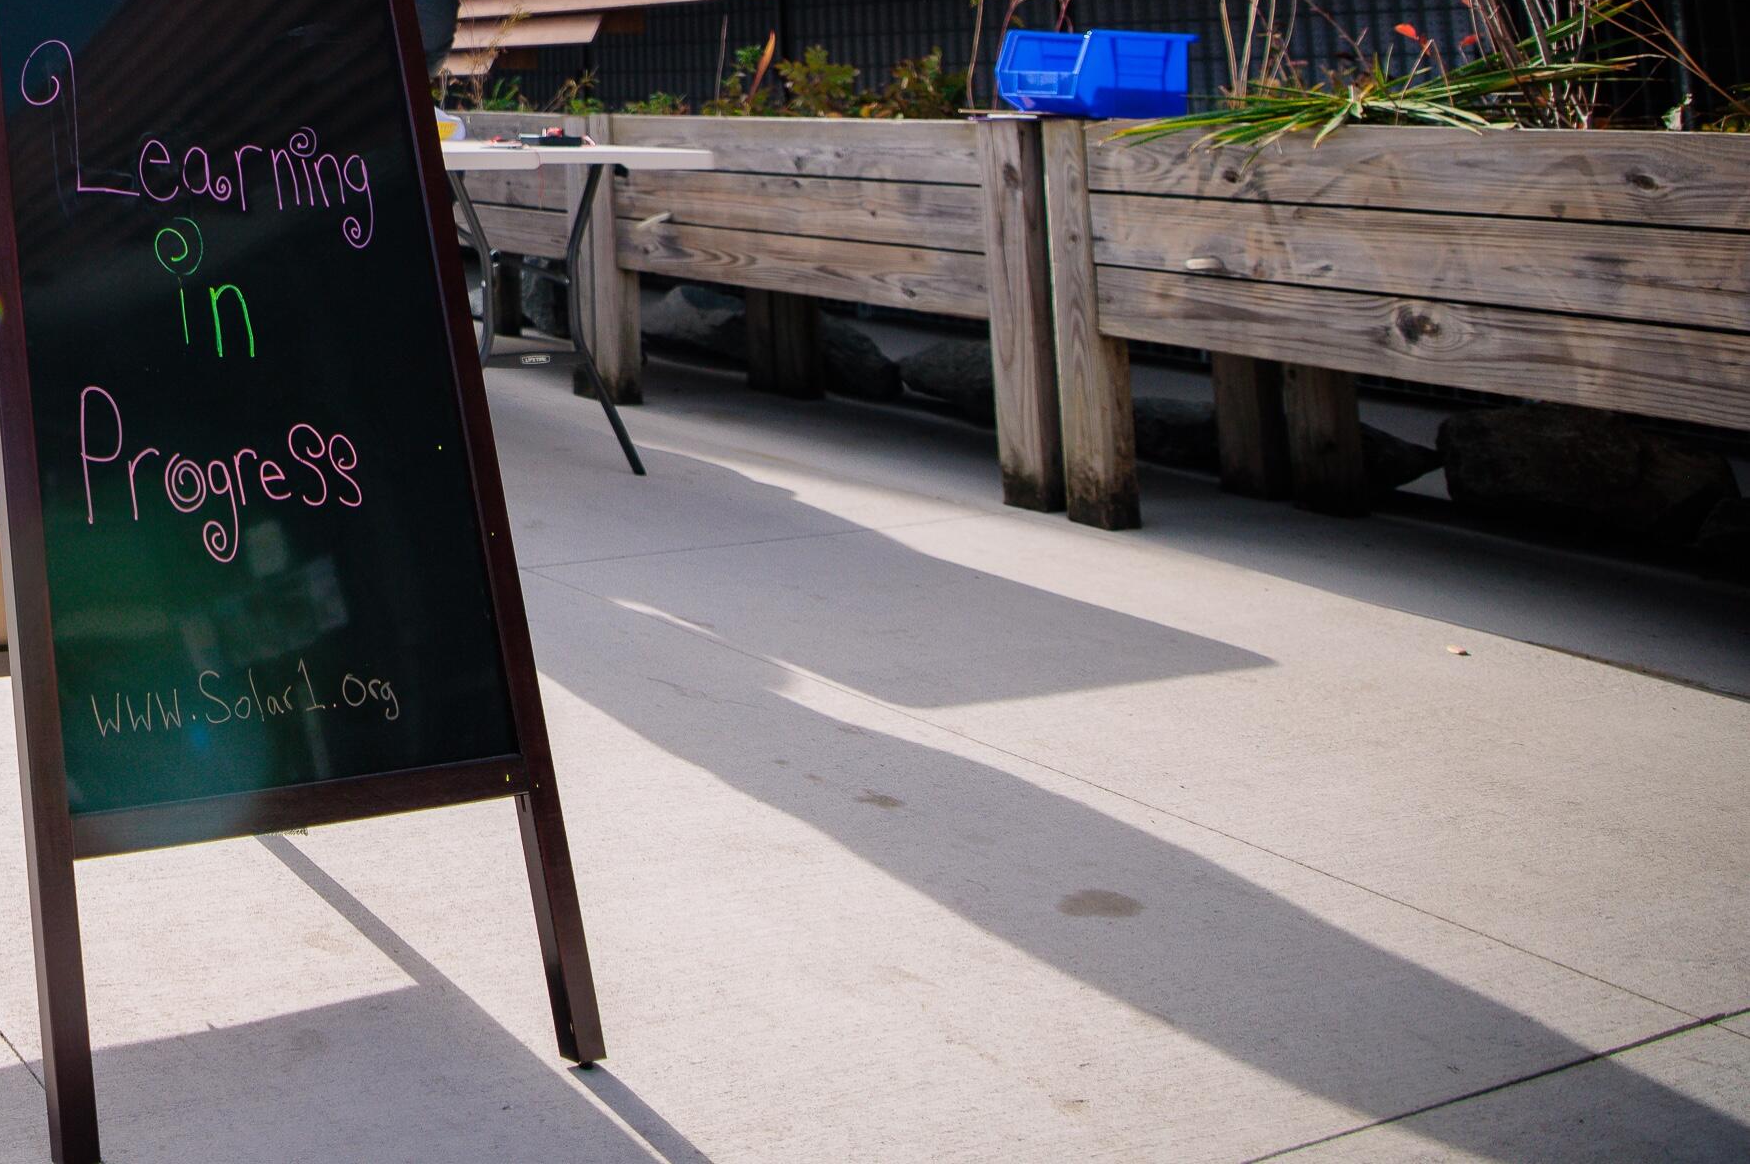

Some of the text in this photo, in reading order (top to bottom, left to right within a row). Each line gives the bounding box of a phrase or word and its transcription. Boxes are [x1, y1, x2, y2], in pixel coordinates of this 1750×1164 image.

[21, 39, 373, 248] Learning
[155, 217, 255, 357] in
[80, 386, 362, 562] Progress
